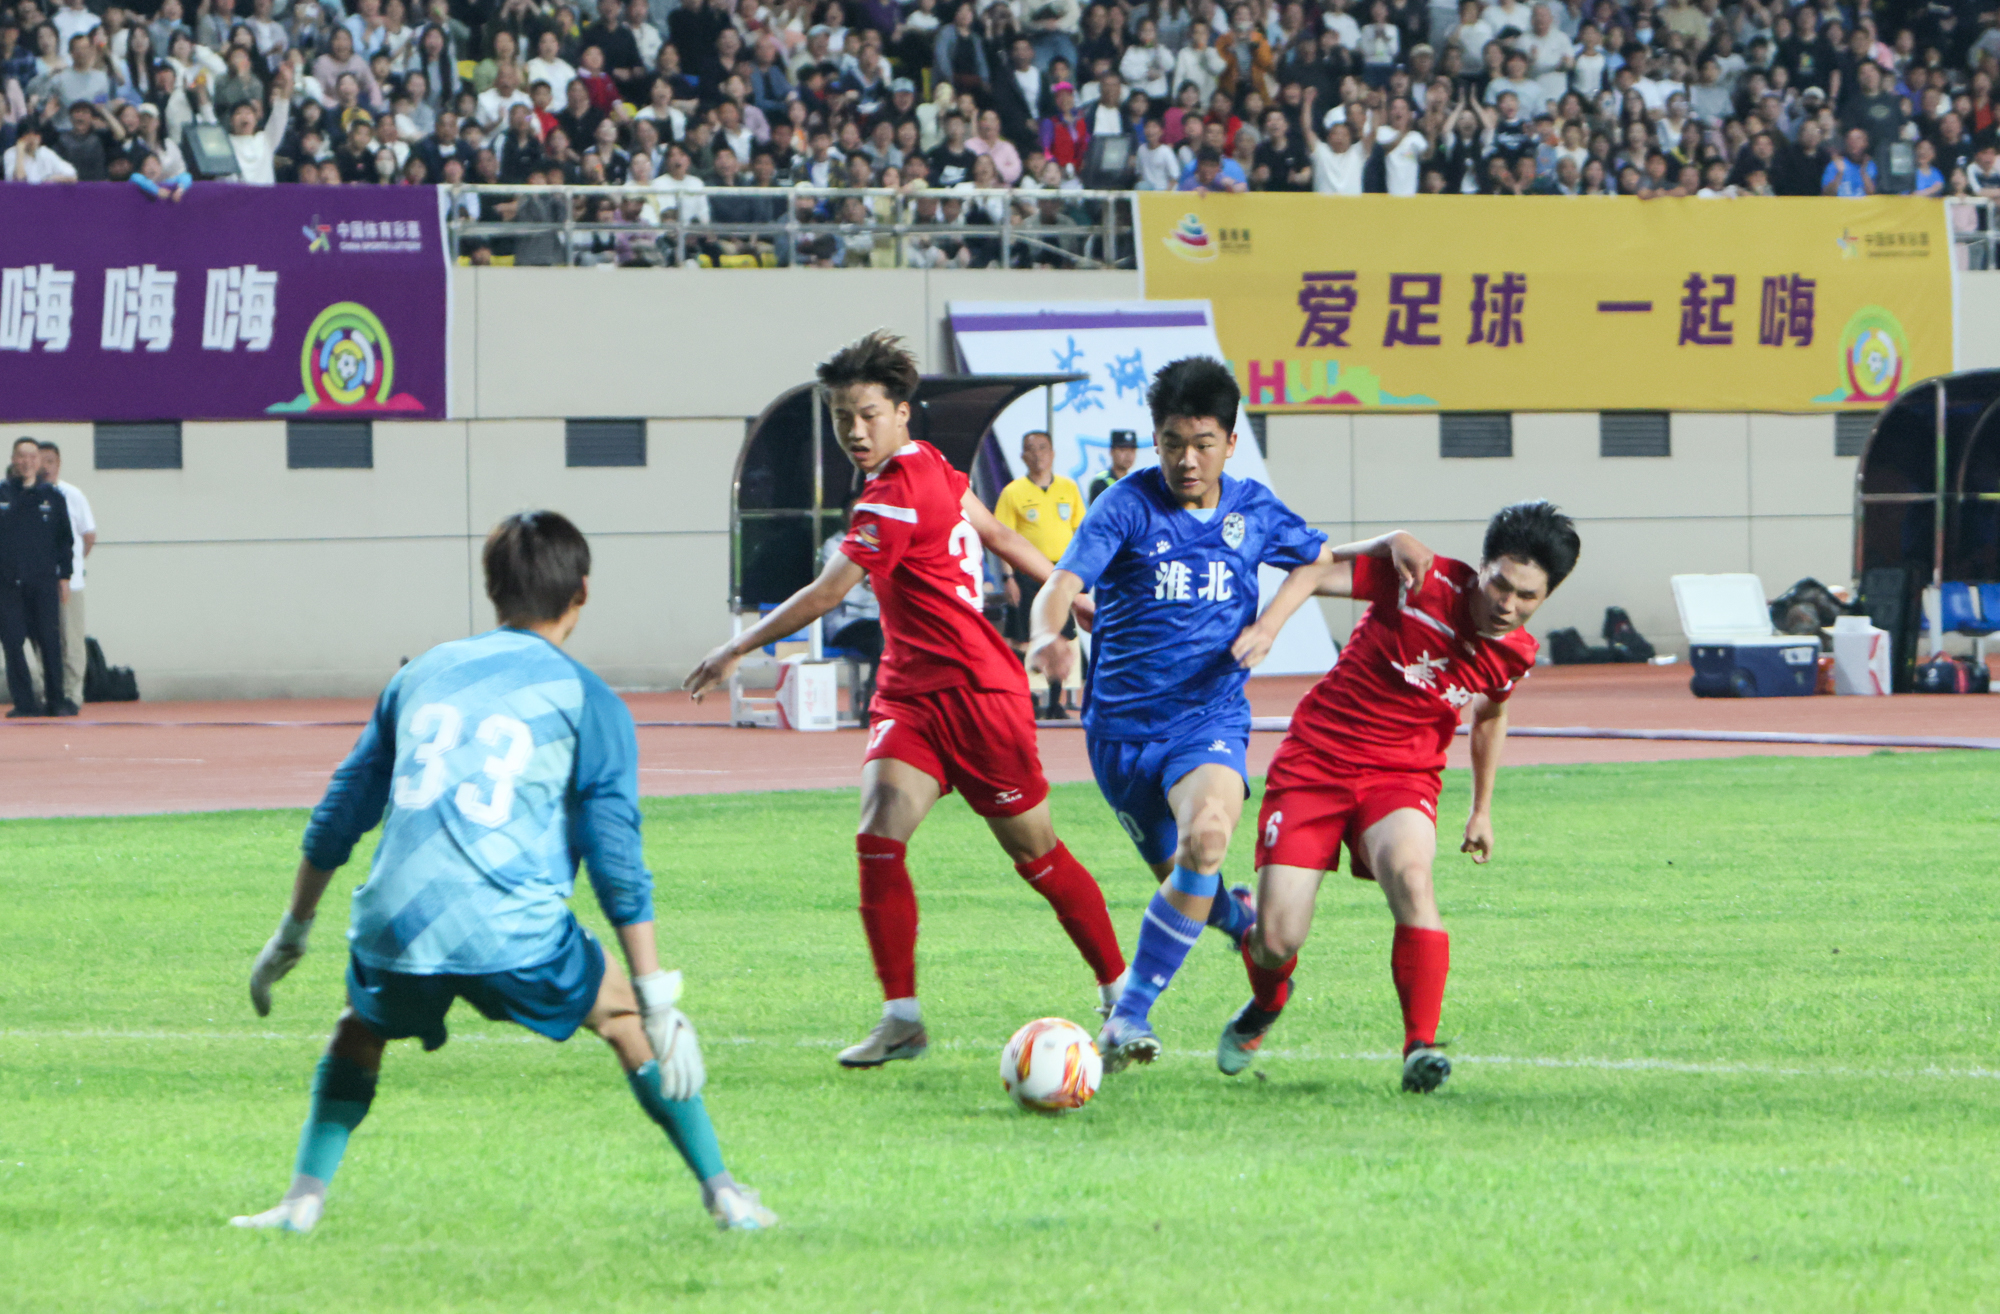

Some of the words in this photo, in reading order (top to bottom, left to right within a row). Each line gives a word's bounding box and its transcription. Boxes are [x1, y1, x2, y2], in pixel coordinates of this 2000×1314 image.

[337, 220, 421, 239] 中国体育彩票
[0, 263, 279, 352] 嗨嗨嗨
[1295, 270, 1527, 348] 爱足球
[1597, 272, 1817, 347] 一起嗨
[1154, 560, 1234, 602] 淮北
[394, 702, 535, 828] 33
[1264, 811, 1283, 848] 6
